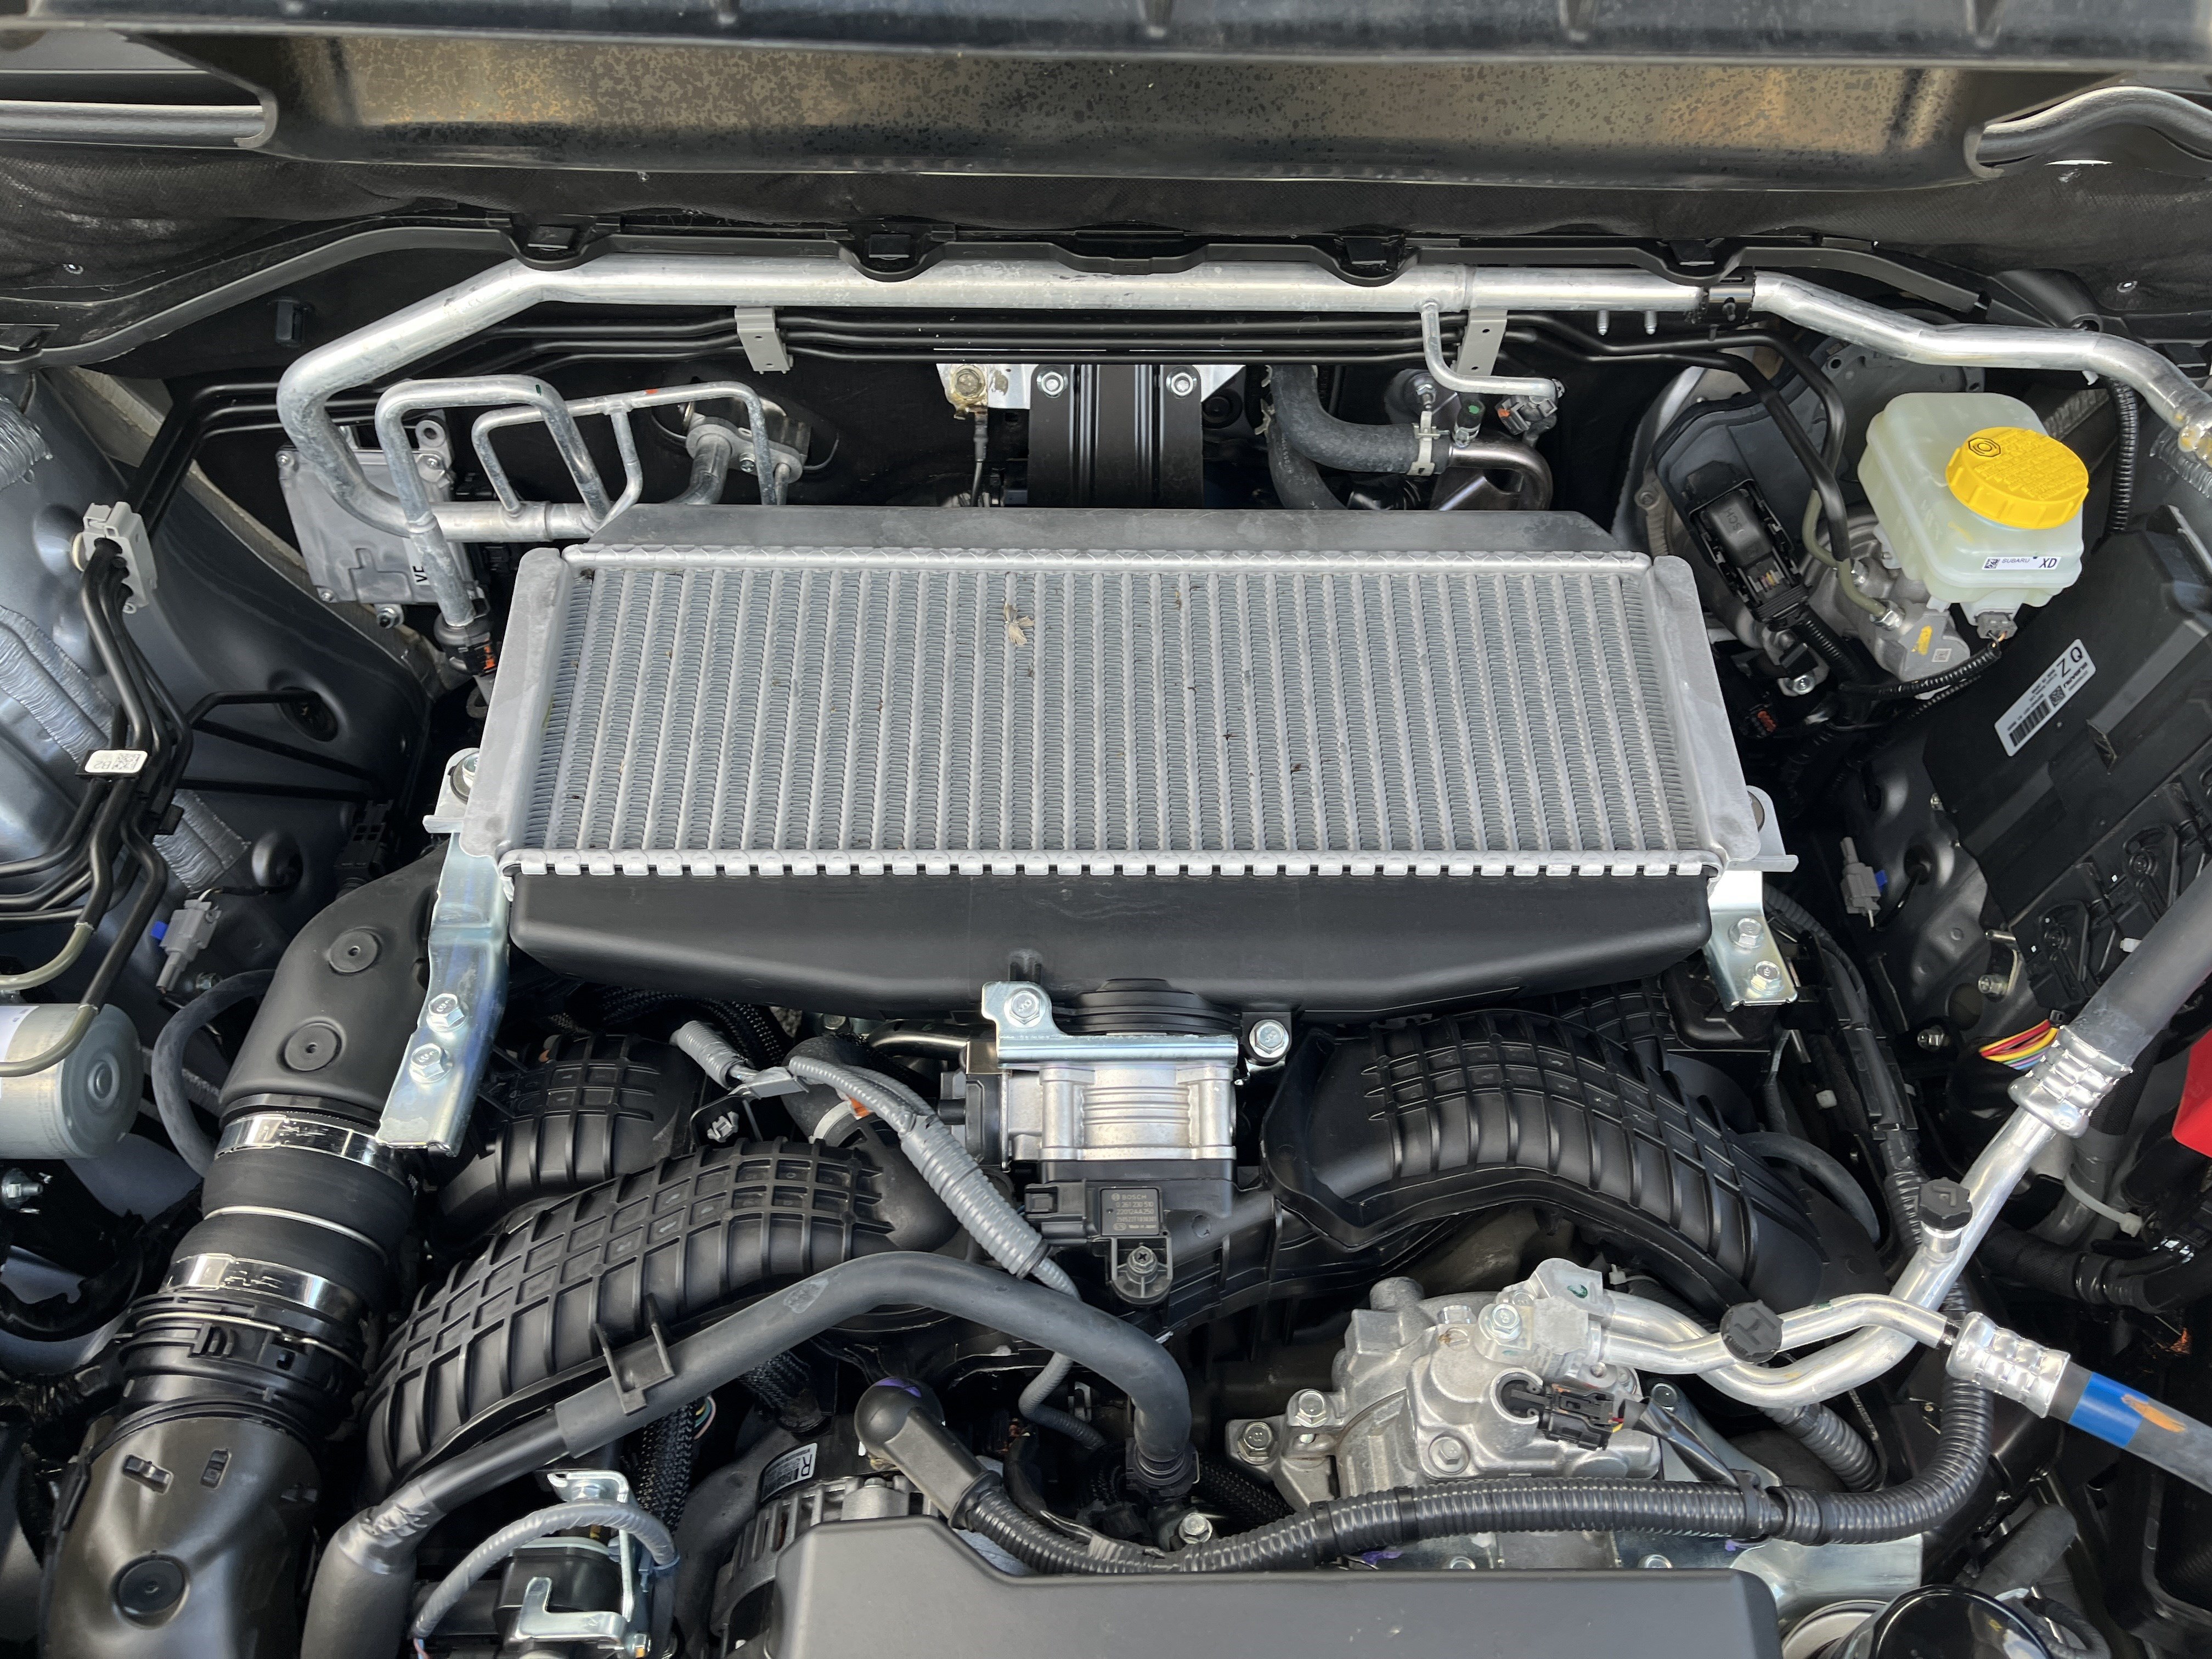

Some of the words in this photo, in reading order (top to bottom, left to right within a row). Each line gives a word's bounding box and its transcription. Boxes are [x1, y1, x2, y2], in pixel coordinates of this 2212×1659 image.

[2038, 558, 2057, 568] XD
[93, 760, 112, 770] B2
[801, 1454, 812, 1477] R
